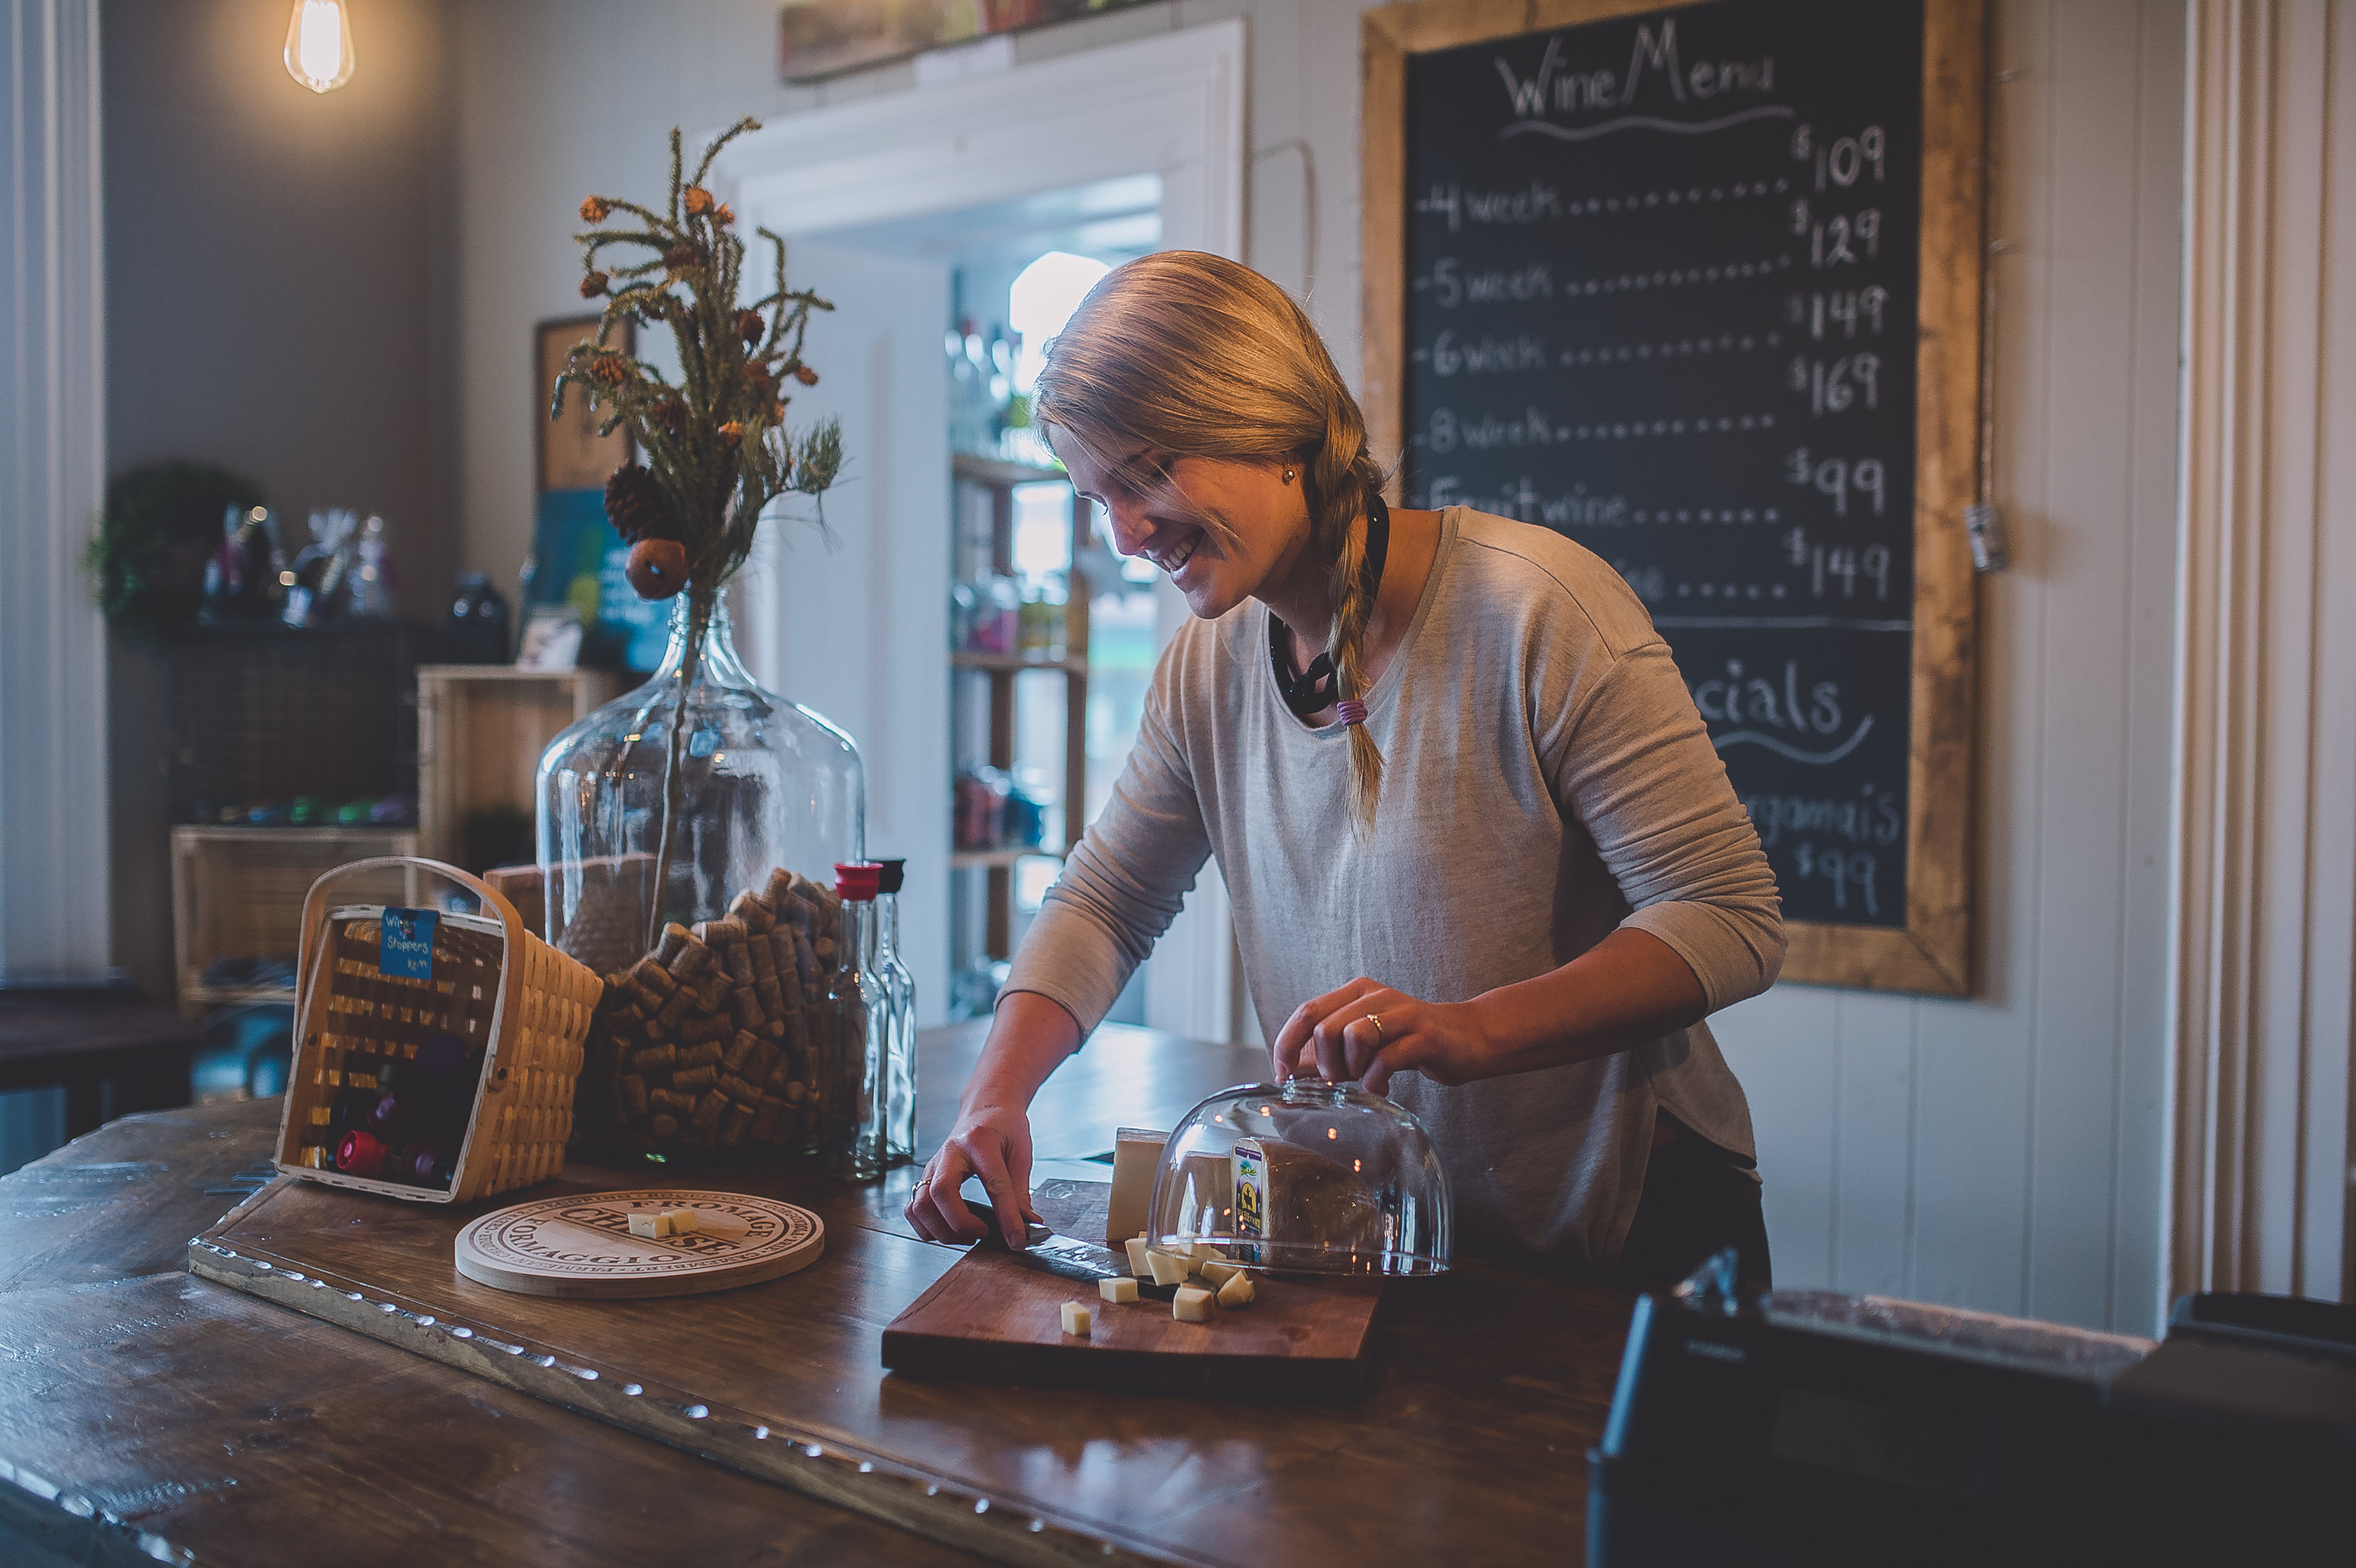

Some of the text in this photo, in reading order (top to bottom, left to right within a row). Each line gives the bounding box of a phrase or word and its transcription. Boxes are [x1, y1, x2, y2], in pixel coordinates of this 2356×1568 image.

[1495, 16, 1775, 116] Wine Menu
[1465, 180, 1562, 224] week
[1790, 123, 1885, 193] $109
[1466, 264, 1554, 304] week
[1790, 199, 1882, 268] $129
[1462, 334, 1544, 374] week
[1461, 405, 1552, 450] week
[1788, 351, 1882, 418] $169
[1784, 446, 1884, 517] $99
[1781, 524, 1891, 600] $149
[1687, 657, 1843, 734] cials
[1793, 839, 1880, 918] $99
[387, 935, 429, 955] Stoppers
[509, 1217, 682, 1264] FORMAGGIO
[560, 1208, 741, 1255] CHSE
[632, 1201, 776, 1237] FROMAGE
[478, 1233, 510, 1258] CHEDDAR
[514, 1258, 613, 1272] PARMESAN
[631, 1252, 759, 1272] CAMEMBERT
[764, 1238, 798, 1251] BRIE
